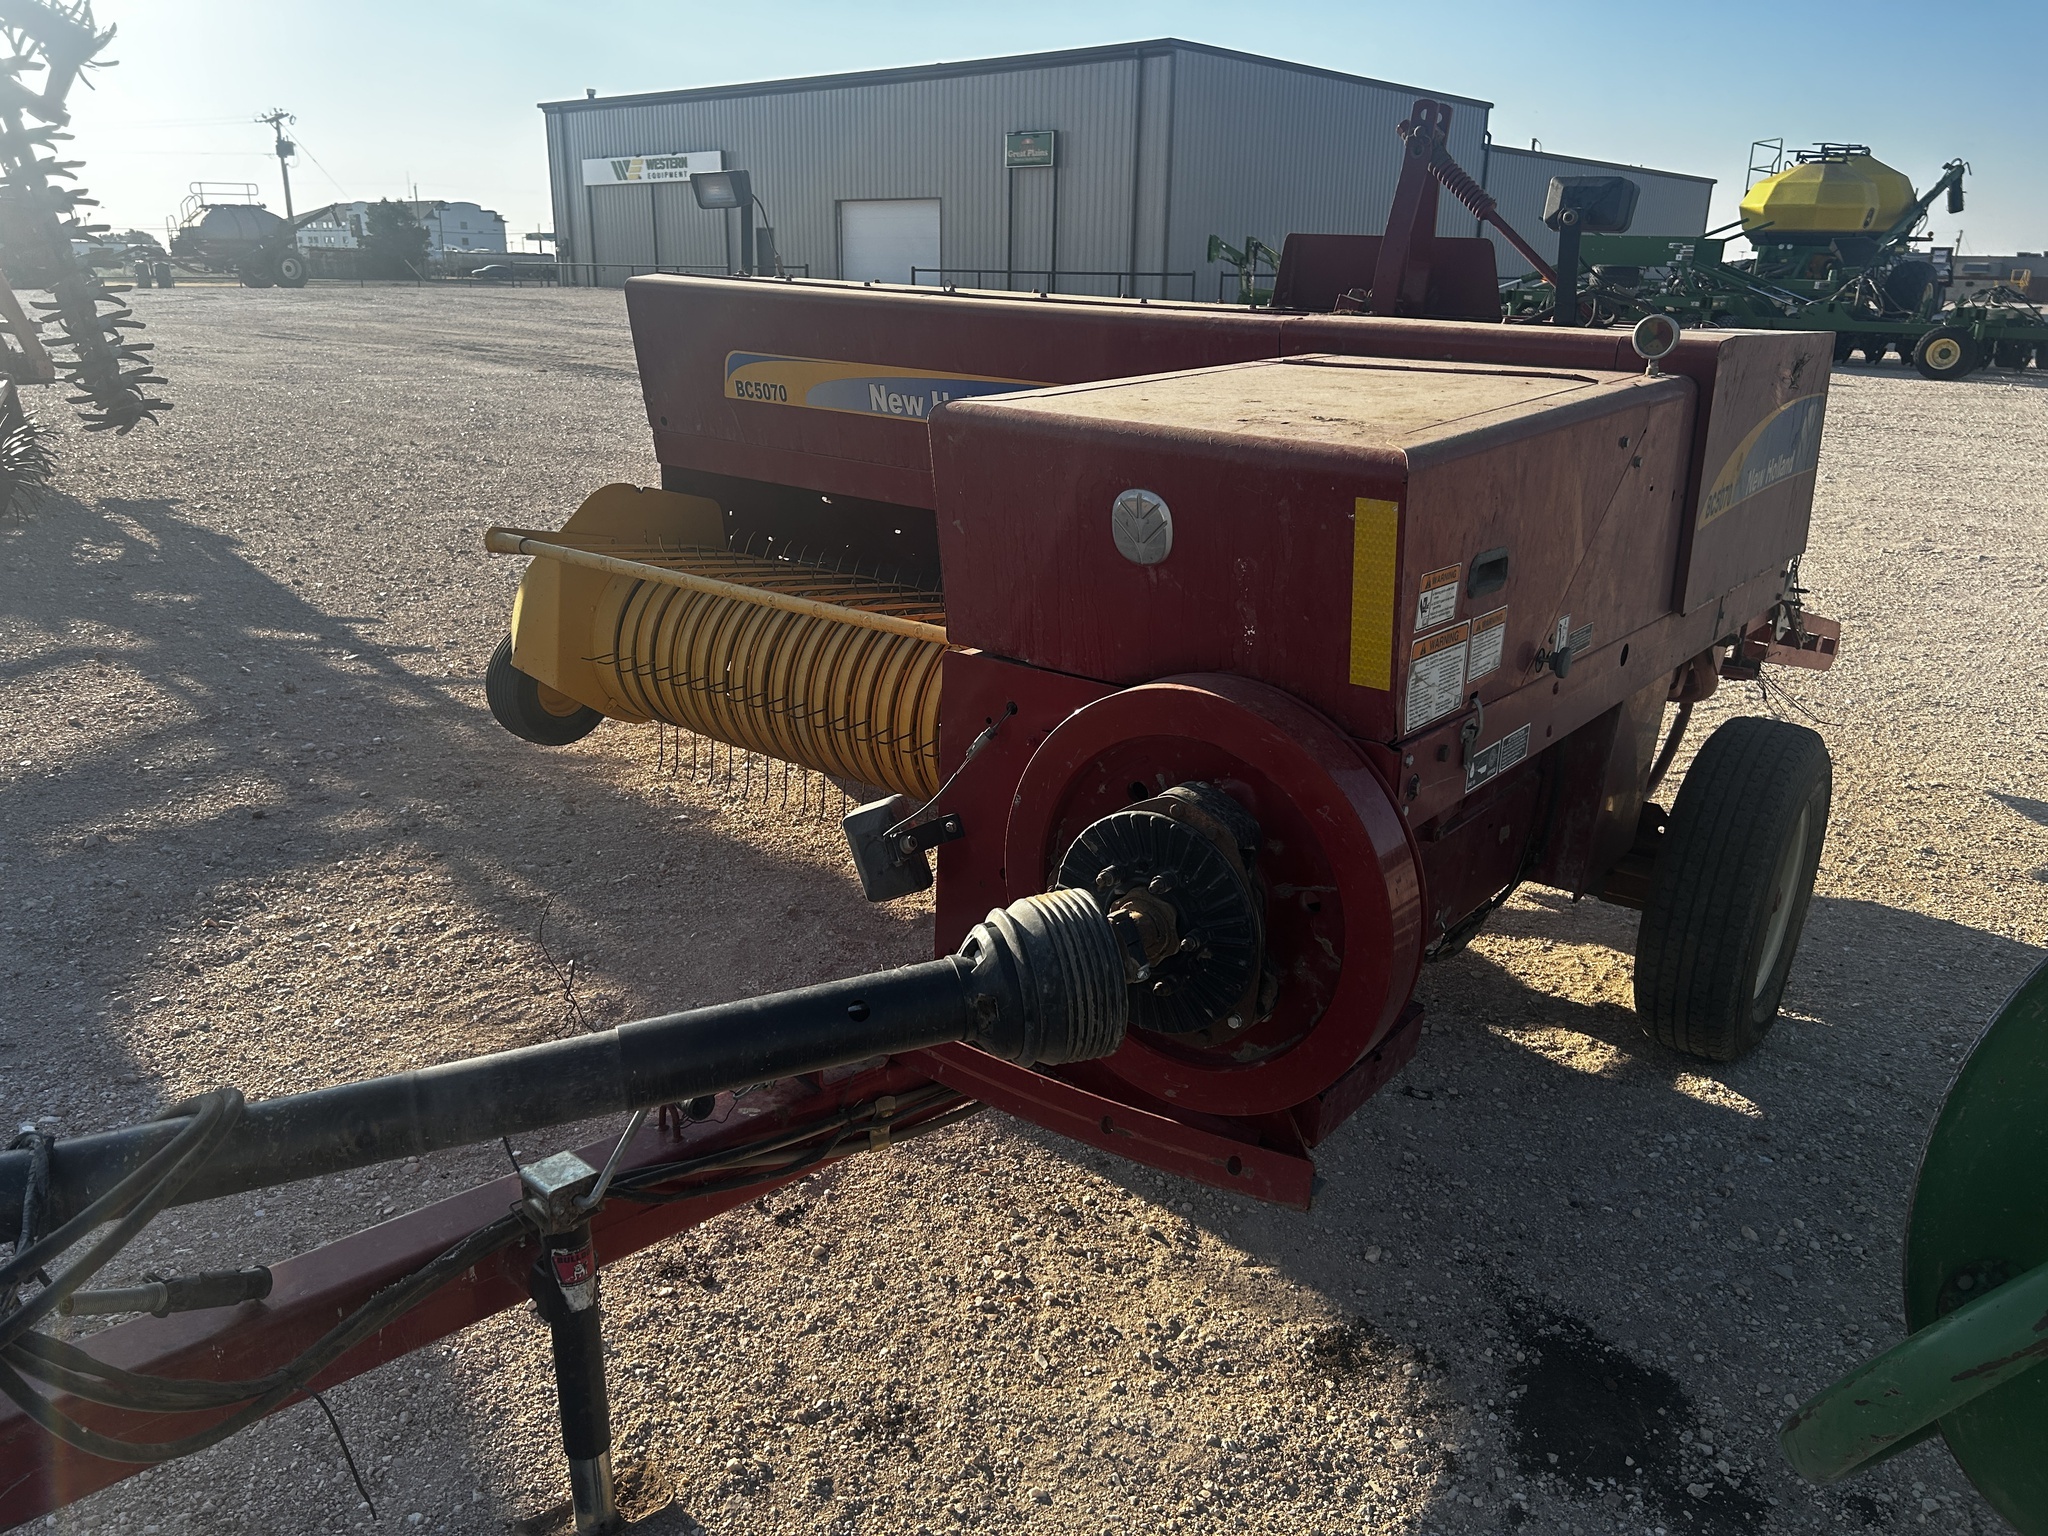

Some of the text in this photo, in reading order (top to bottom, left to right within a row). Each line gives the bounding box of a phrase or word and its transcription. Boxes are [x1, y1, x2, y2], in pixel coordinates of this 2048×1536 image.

[646, 157, 688, 170] WESTERN
[647, 171, 688, 179] EQUIPMENT
[734, 380, 788, 403] BC5070
[868, 383, 924, 417] New
[1745, 467, 1767, 496] New
[1766, 450, 1795, 483] Holland
[1432, 569, 1457, 585] WARNING
[1430, 631, 1460, 650] WARNING
